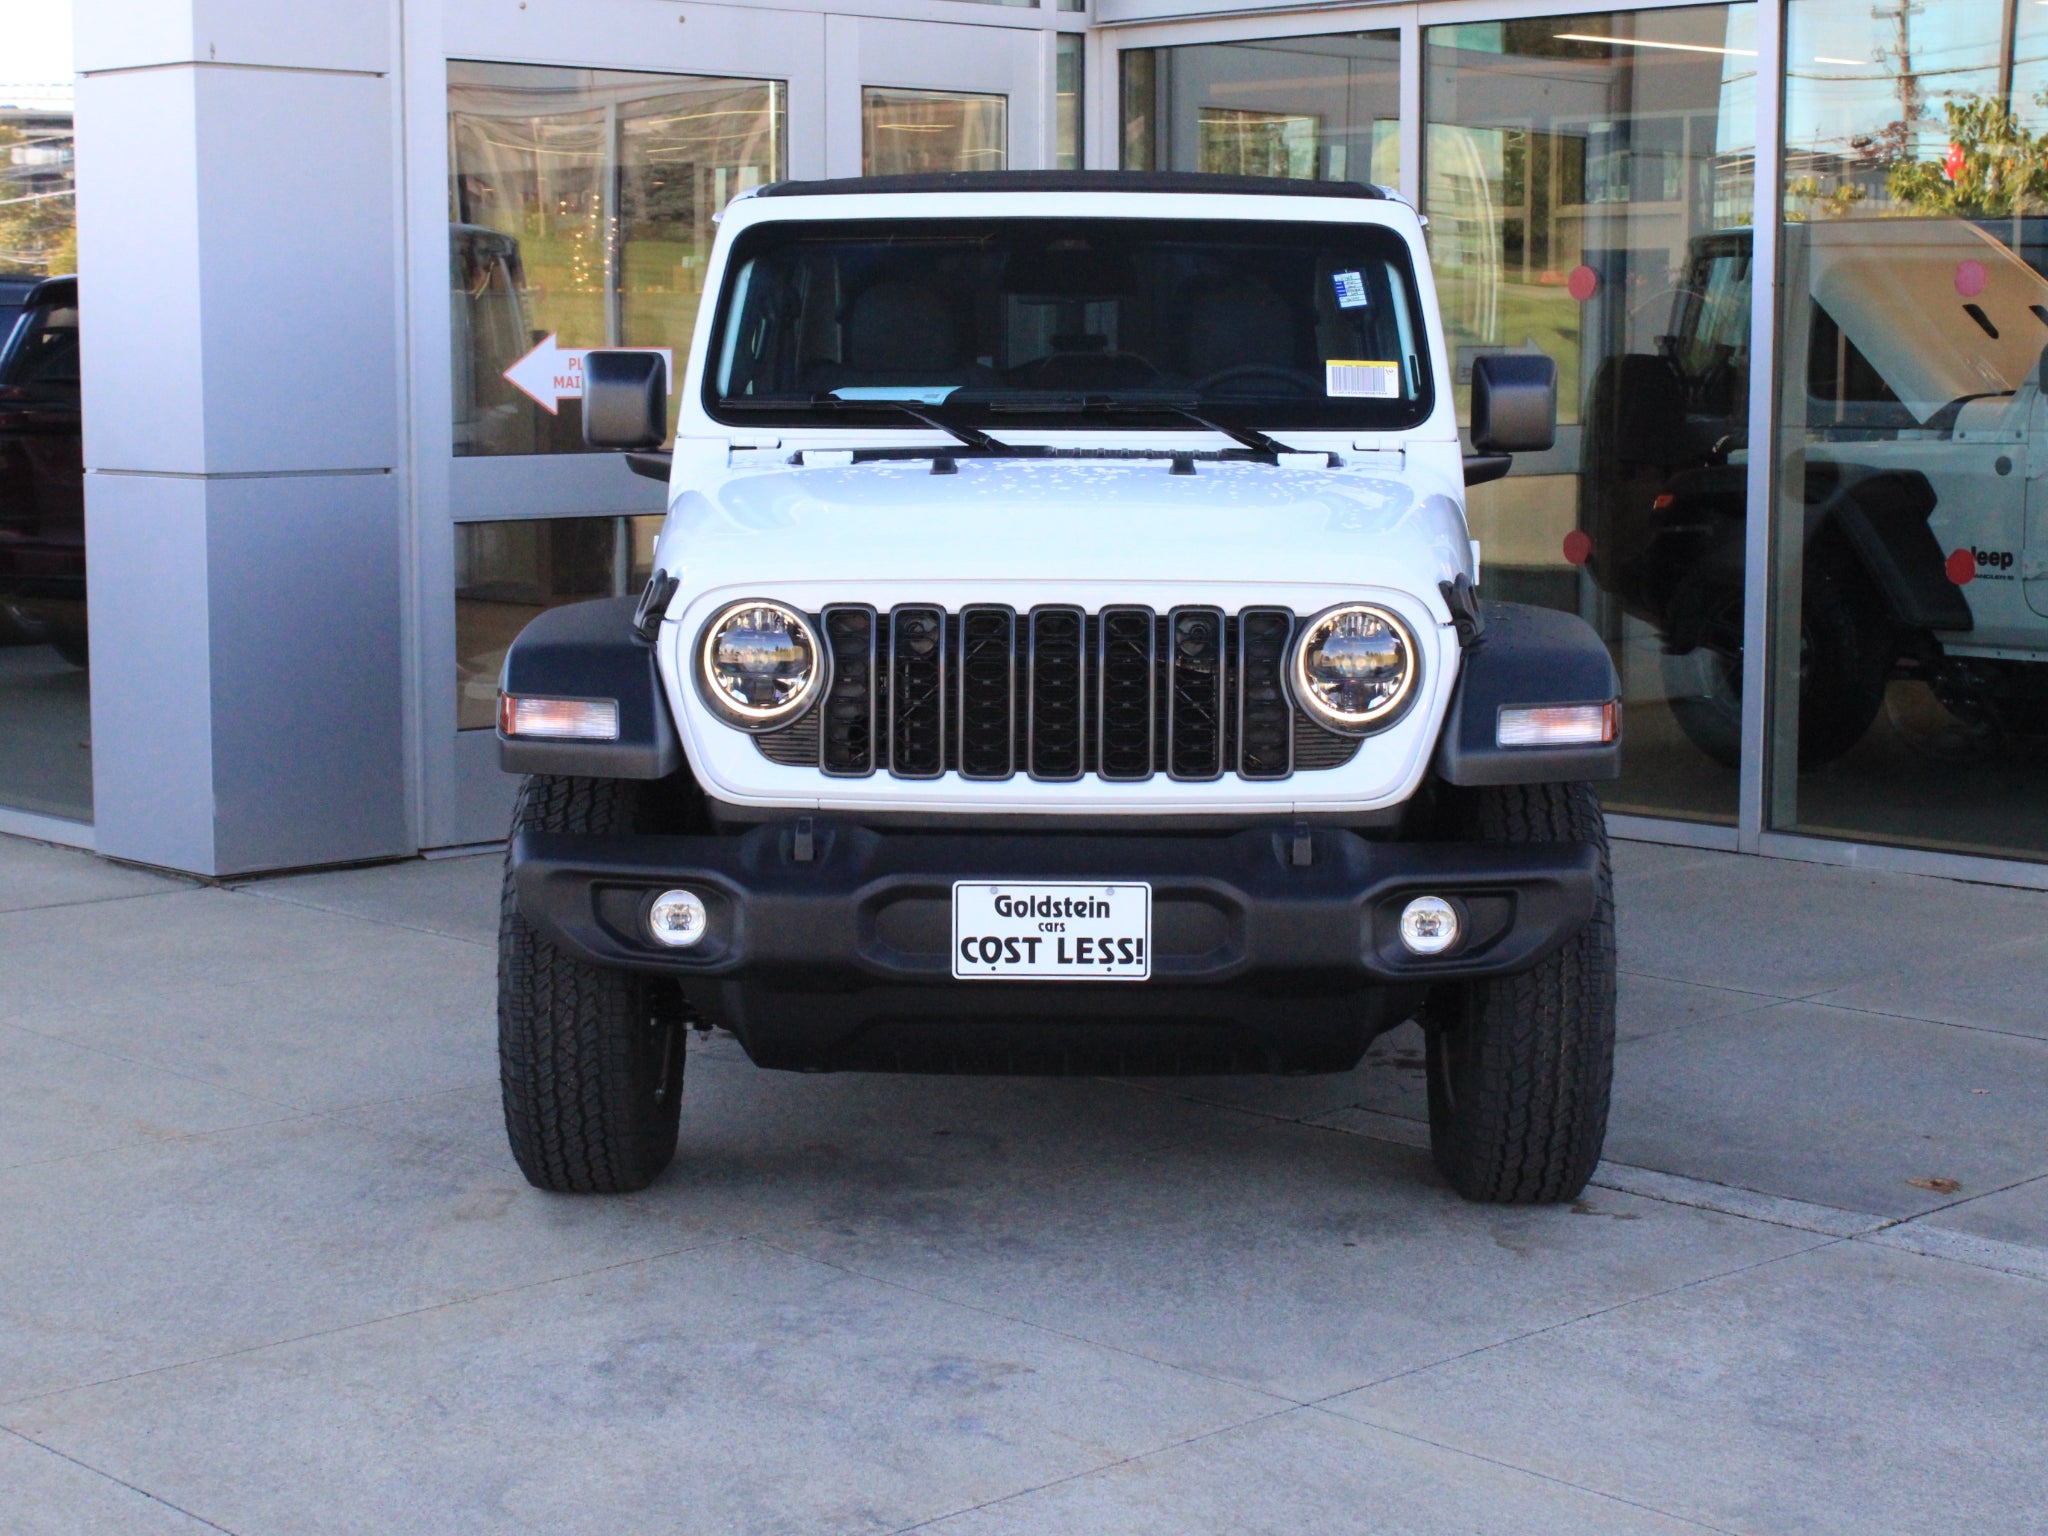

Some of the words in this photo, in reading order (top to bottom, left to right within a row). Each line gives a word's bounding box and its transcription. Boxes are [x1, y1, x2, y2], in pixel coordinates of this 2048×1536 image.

[553, 375, 582, 389] MAI
[994, 895, 1110, 918] Goldstein
[1038, 922, 1065, 932] cars
[961, 936, 1043, 964] COST
[1057, 937, 1143, 965] LESS!
